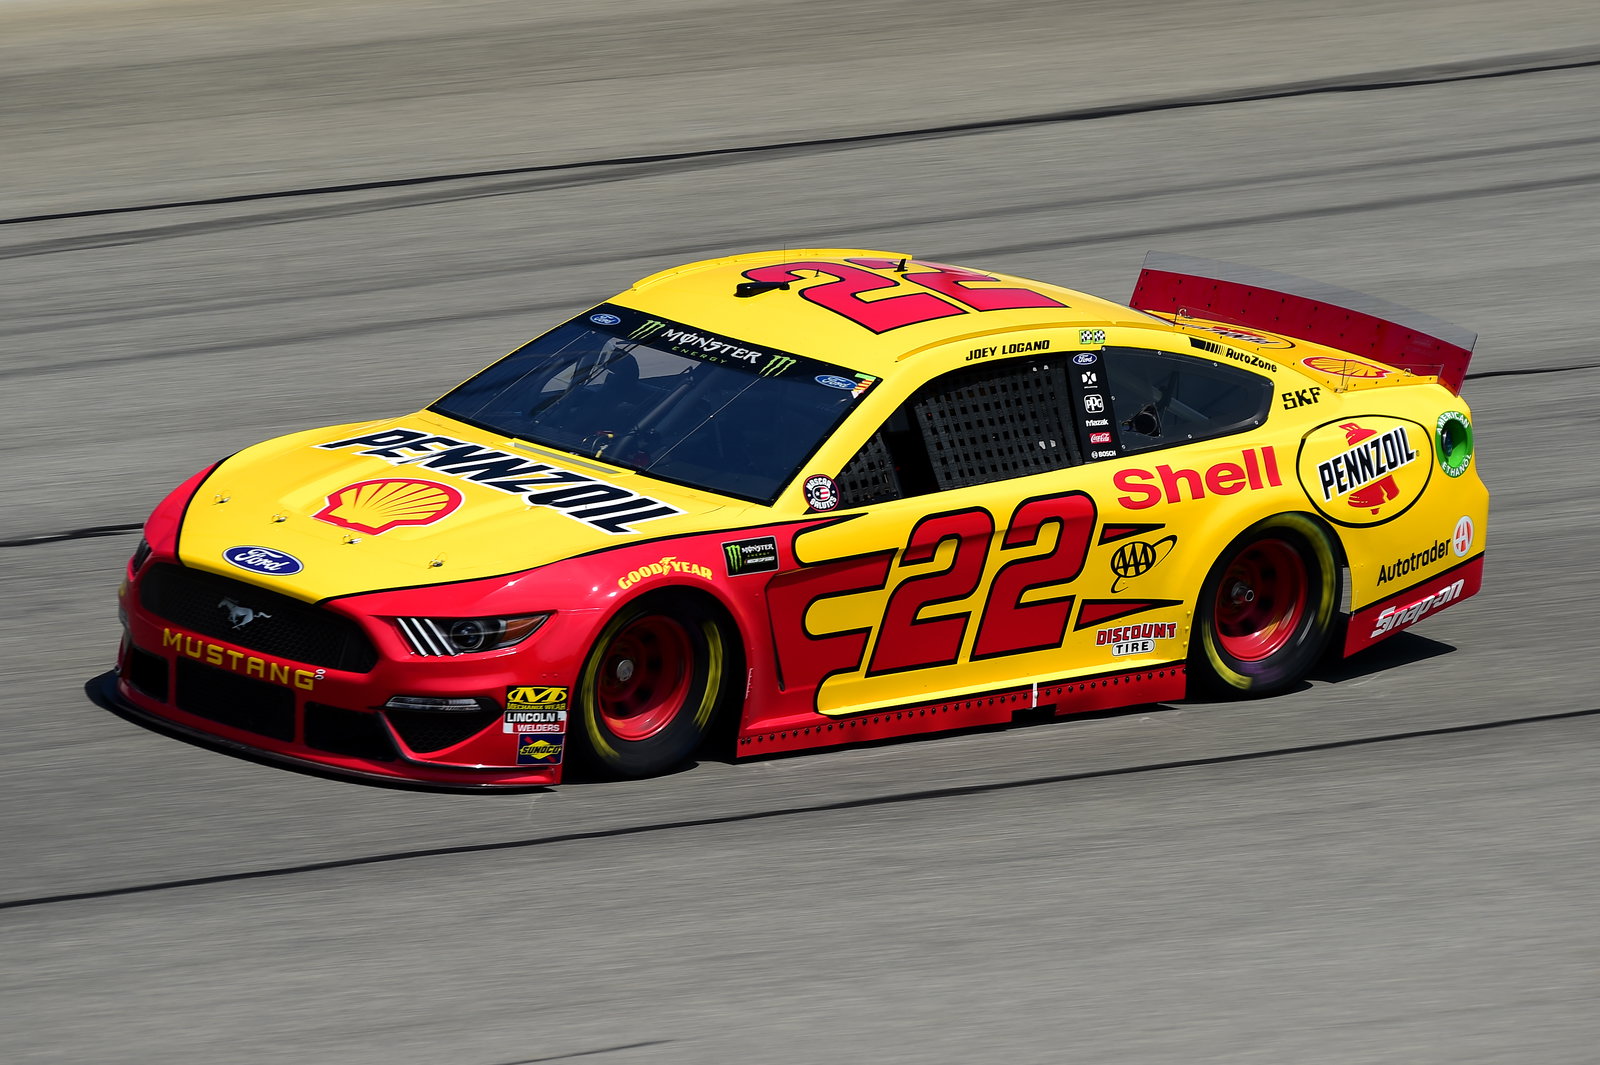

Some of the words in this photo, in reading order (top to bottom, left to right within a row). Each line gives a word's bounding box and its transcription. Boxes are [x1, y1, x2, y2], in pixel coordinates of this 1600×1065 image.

[672, 346, 728, 364] ENERGY
[965, 346, 997, 362] JOEY
[1002, 339, 1050, 355] LOGANO
[1226, 347, 1278, 373] AutoZone
[1086, 396, 1103, 411] PPG
[1281, 386, 1321, 410] SKF
[1085, 419, 1109, 427] Mazak
[1437, 411, 1469, 435] AMERICAN
[1098, 450, 1117, 458] BOSCH
[1318, 426, 1416, 501] PENNZOIL
[1441, 453, 1472, 476] ETHANOL
[316, 428, 682, 533] PENNZOIL
[806, 477, 832, 490] NASCAR
[1112, 446, 1282, 510] Shell
[810, 495, 837, 509] SALUTES
[233, 546, 291, 572] Ford
[1112, 541, 1155, 578] AAA
[1376, 538, 1452, 587] Autotrader
[864, 489, 1098, 678] 22
[1096, 622, 1177, 646] DISCOUNT
[1116, 641, 1149, 654] TIRE
[162, 628, 316, 691] MUSTANG
[507, 712, 555, 723] LINCOLN
[517, 724, 560, 732] WELDERS
[521, 745, 562, 754] SUNOCO
